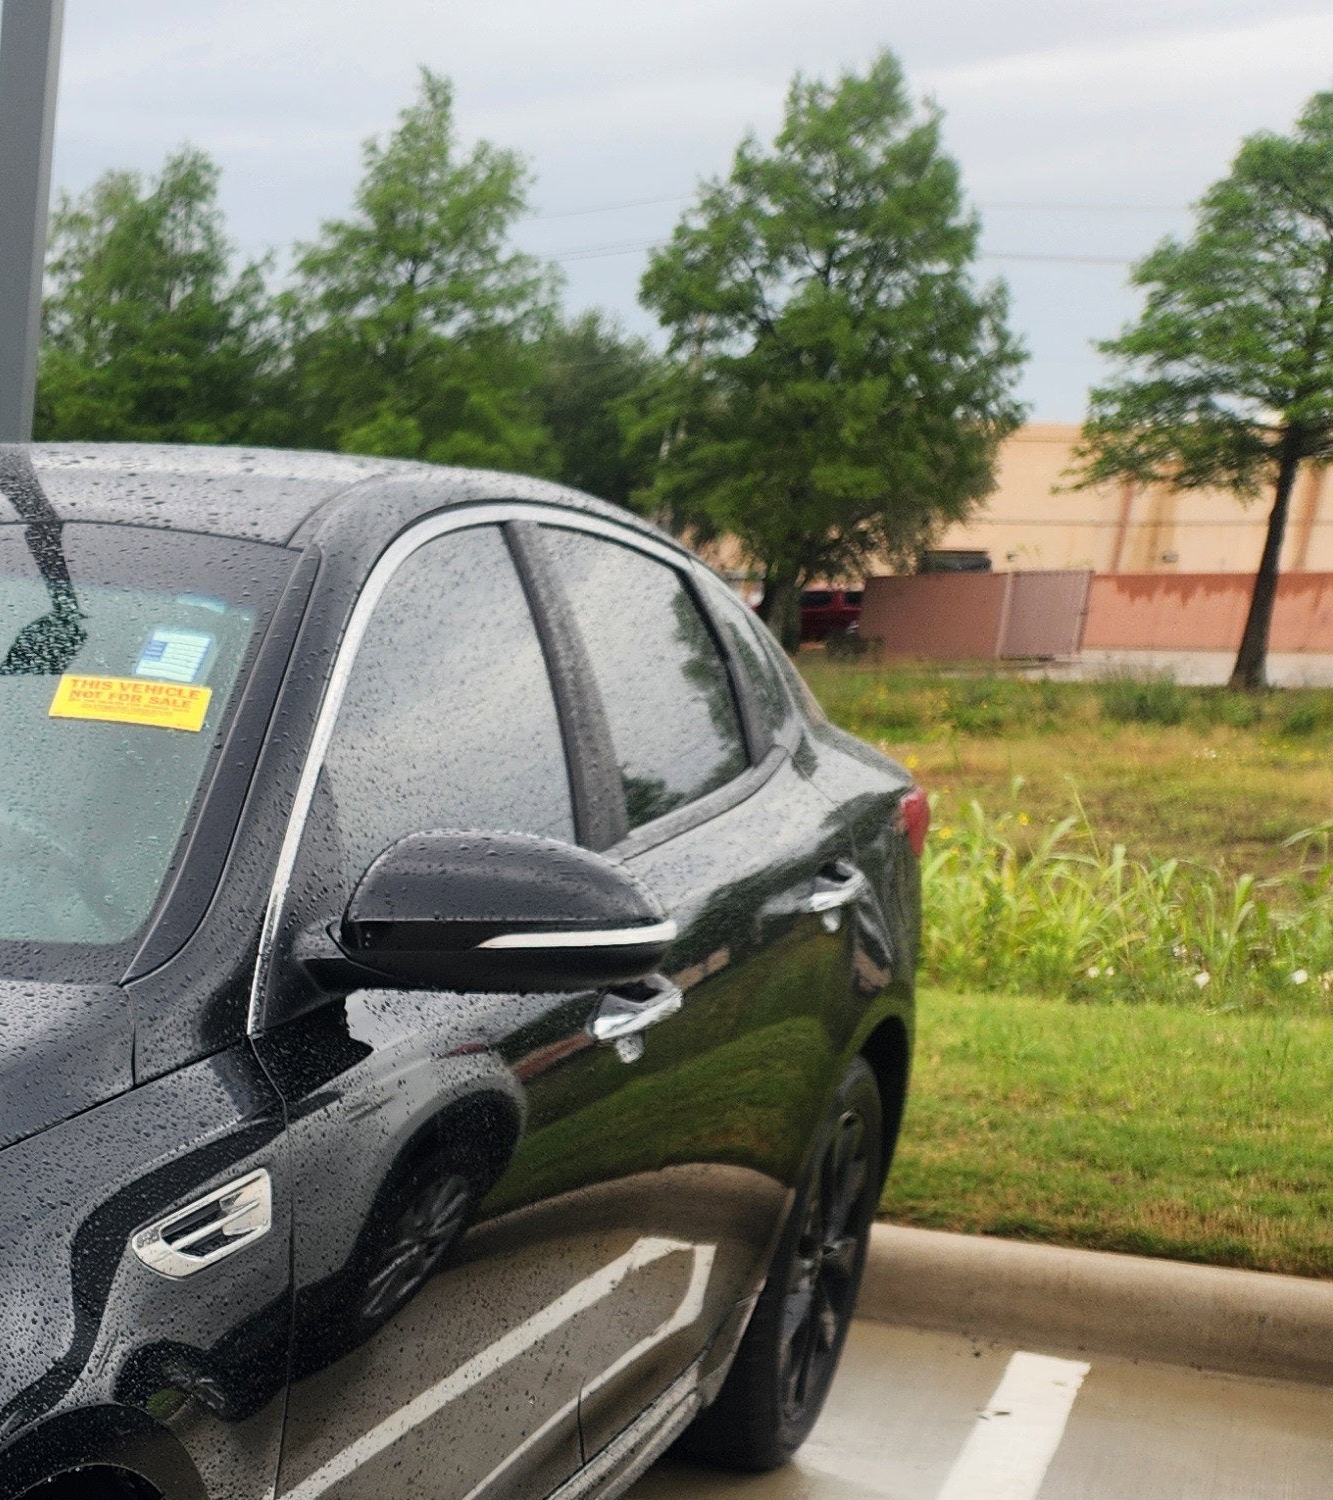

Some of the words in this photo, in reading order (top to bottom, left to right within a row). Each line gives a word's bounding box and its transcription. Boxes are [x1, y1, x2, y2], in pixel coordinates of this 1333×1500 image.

[71, 679, 112, 691] THIS
[120, 683, 201, 699] VEHICLE
[70, 690, 102, 699] NOT
[108, 693, 142, 703] FOR
[149, 696, 192, 709] SALE
